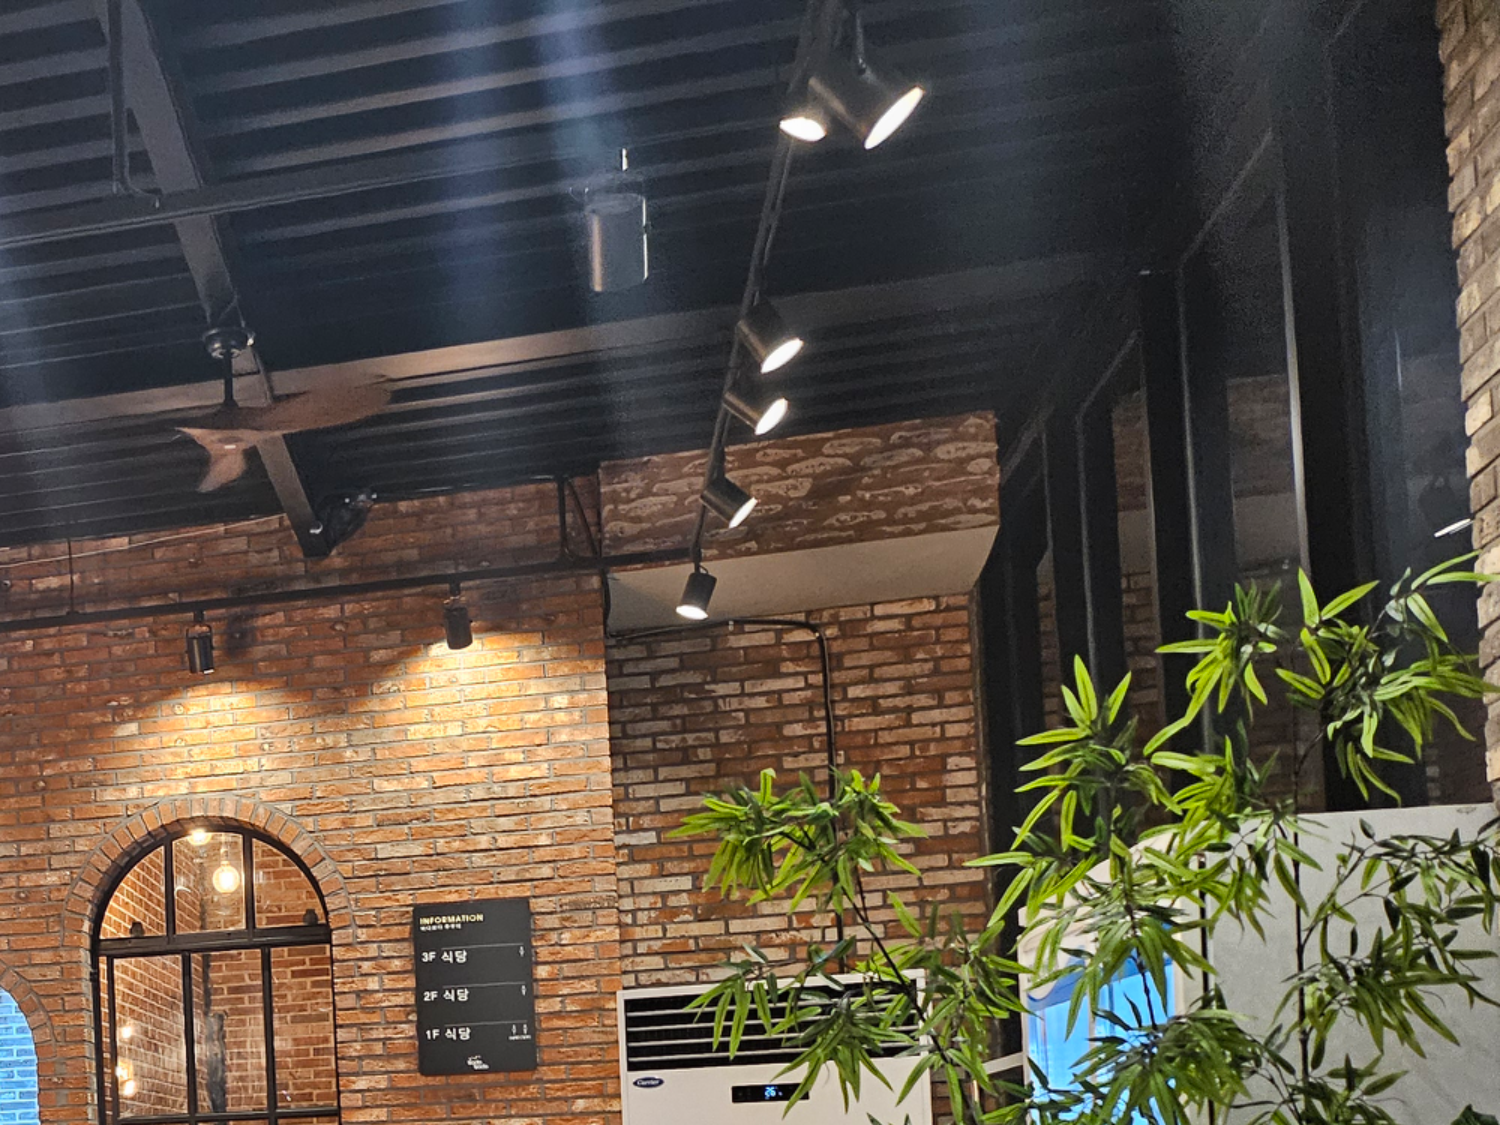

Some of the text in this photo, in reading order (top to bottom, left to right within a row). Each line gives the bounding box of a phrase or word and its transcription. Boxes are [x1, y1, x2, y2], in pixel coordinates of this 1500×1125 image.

[419, 913, 484, 925] INFORMATION
[421, 950, 468, 963] 3F 식당
[423, 988, 469, 1002] 2F 식당
[425, 1027, 471, 1041] 1F 식당
